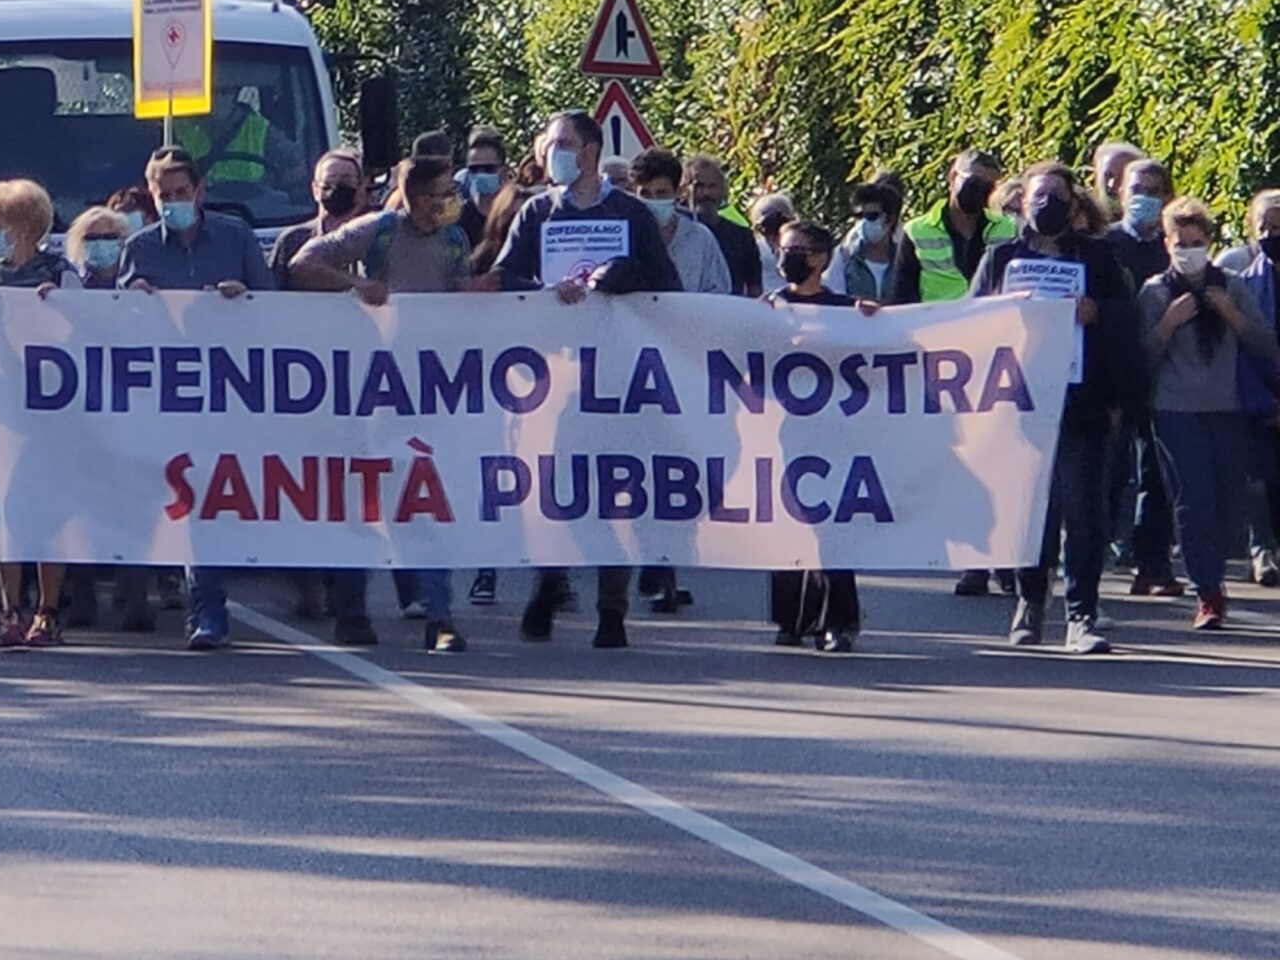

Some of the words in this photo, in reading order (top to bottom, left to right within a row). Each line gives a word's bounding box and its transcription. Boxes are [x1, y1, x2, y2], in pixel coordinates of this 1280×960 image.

[547, 224, 623, 237] DIFENDIAMO
[24, 345, 551, 416] DIFENDIAMO
[579, 346, 682, 415] LA
[706, 346, 1036, 417] NOSTRA
[163, 436, 456, 524] SANITÀ
[478, 453, 895, 524] PUBBLICA
